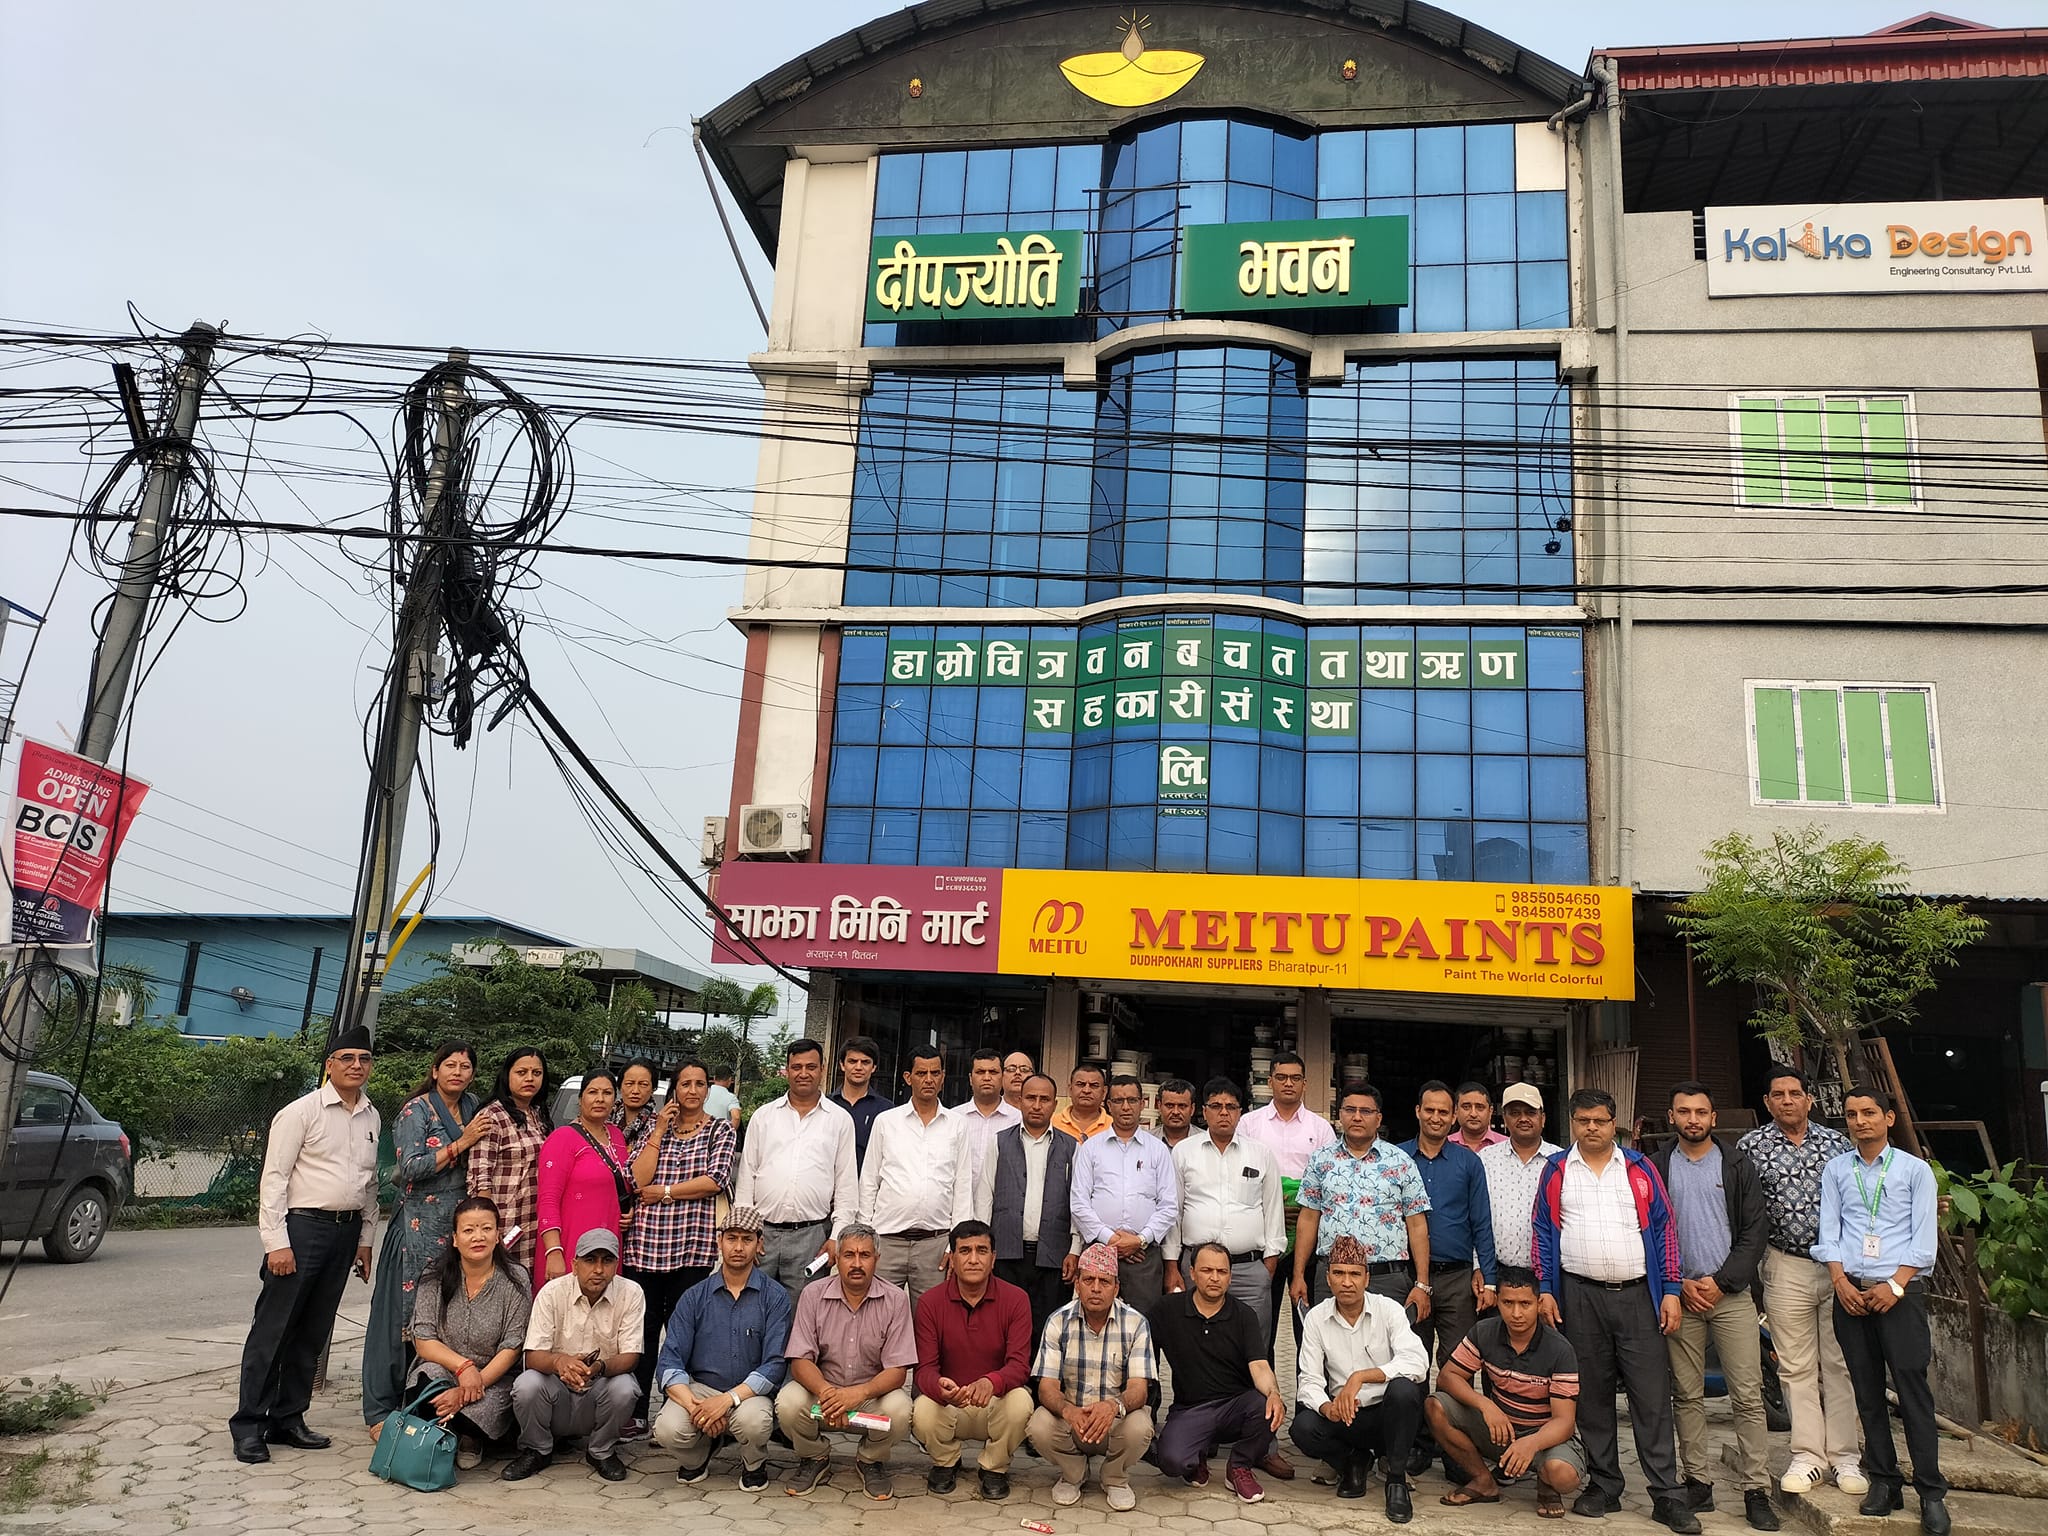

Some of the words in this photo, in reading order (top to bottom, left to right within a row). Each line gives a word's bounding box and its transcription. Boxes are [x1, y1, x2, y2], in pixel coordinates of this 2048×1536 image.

[1886, 224, 2033, 265] Design
[875, 233, 1064, 314] दीपज्योति
[1238, 238, 1356, 297] भवन
[1889, 266, 1940, 277] Engineering
[1941, 266, 1995, 276] Consultancy
[44, 767, 113, 798] ADMISSIONS
[37, 777, 108, 819] OPEN
[1511, 891, 1601, 906] 9855054650
[829, 894, 912, 944] मिनि
[921, 901, 990, 946] मार्ट
[1511, 905, 1601, 920] 9845807439
[1029, 938, 1087, 955] MEITU
[1128, 908, 1351, 955] MEITU
[1364, 915, 1606, 966] PAINTS
[1130, 954, 1203, 969] DUDHPOKHARI
[1207, 957, 1263, 971] SUPPLIERS
[1268, 959, 1348, 976] Bharatpur-11
[1444, 968, 1477, 981] Paint
[1480, 969, 1504, 982] The
[1507, 971, 1545, 984] World
[1550, 972, 1604, 986] Colorful
